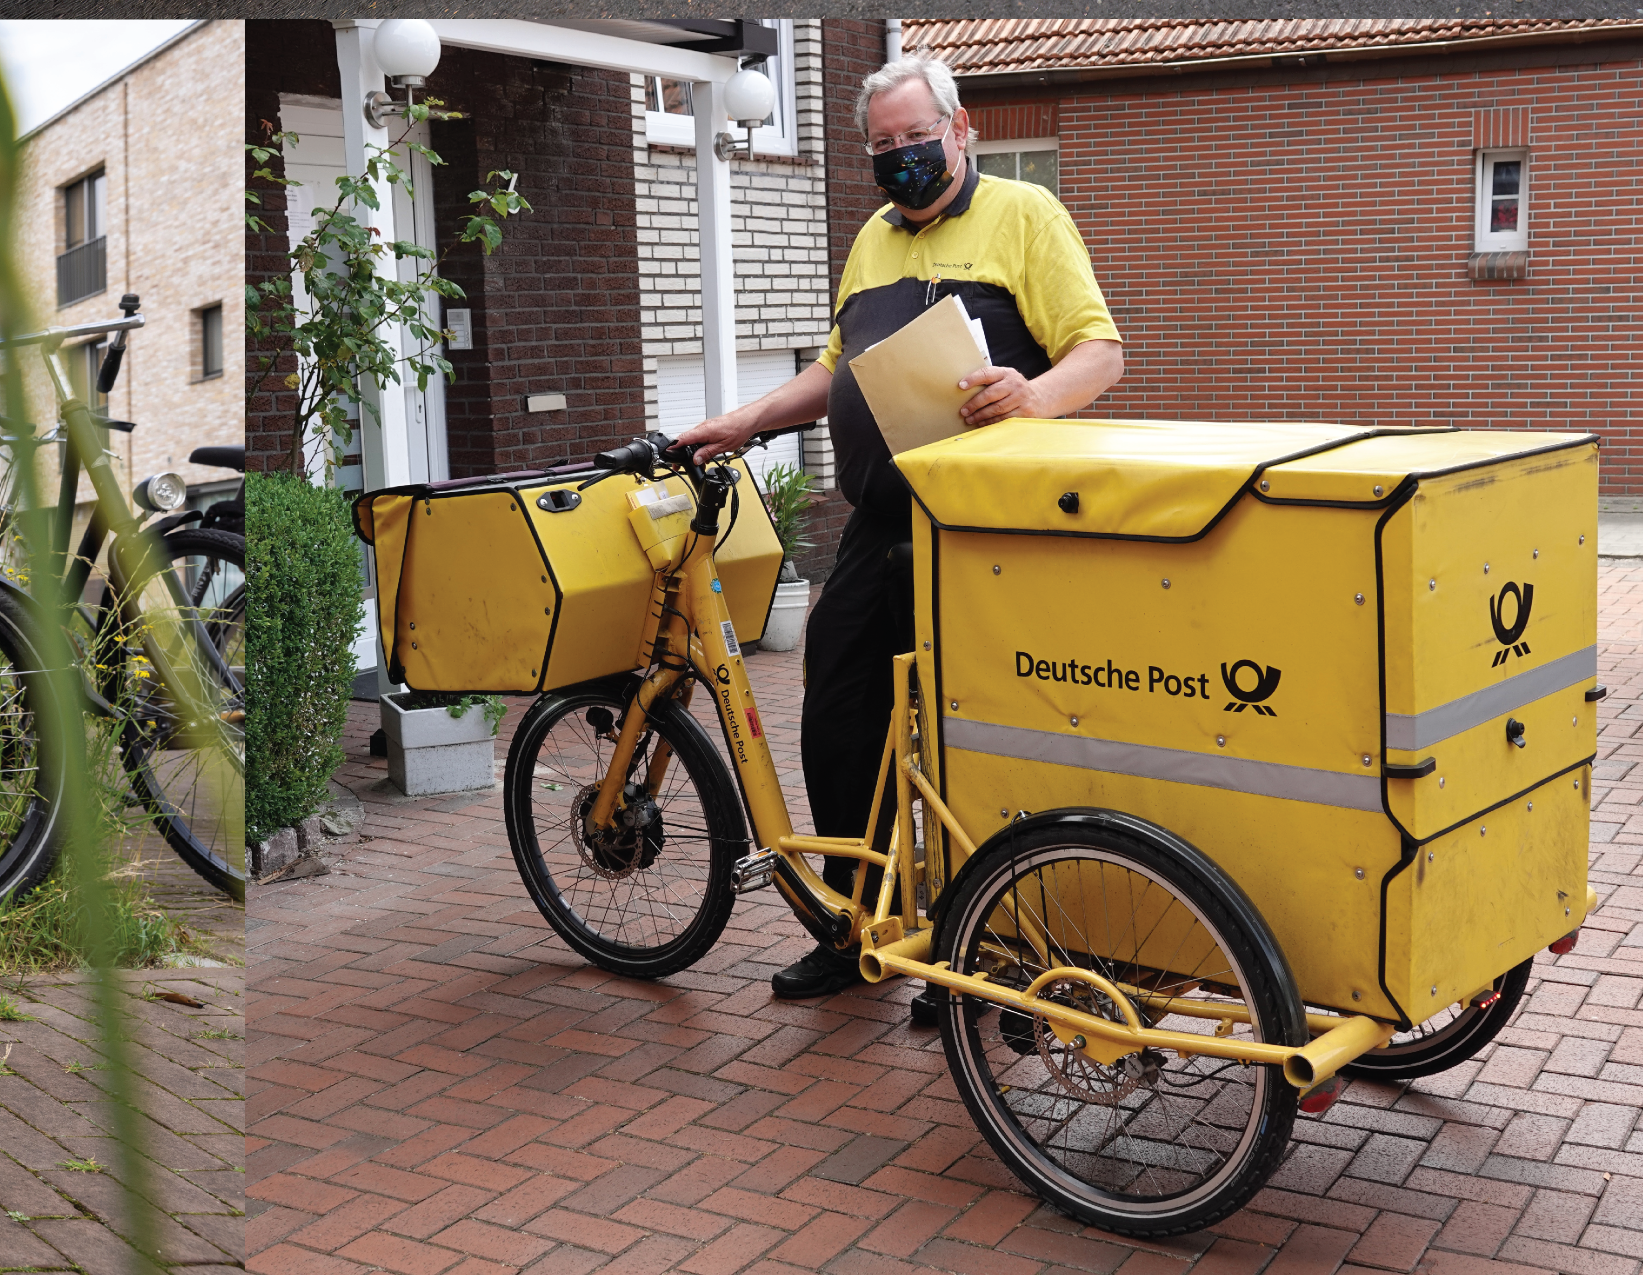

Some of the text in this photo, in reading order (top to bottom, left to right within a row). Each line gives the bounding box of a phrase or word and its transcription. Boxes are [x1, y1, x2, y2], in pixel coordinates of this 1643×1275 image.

[1015, 651, 1211, 700] Deutsche Post
[721, 689, 748, 764] Deutsche Post
